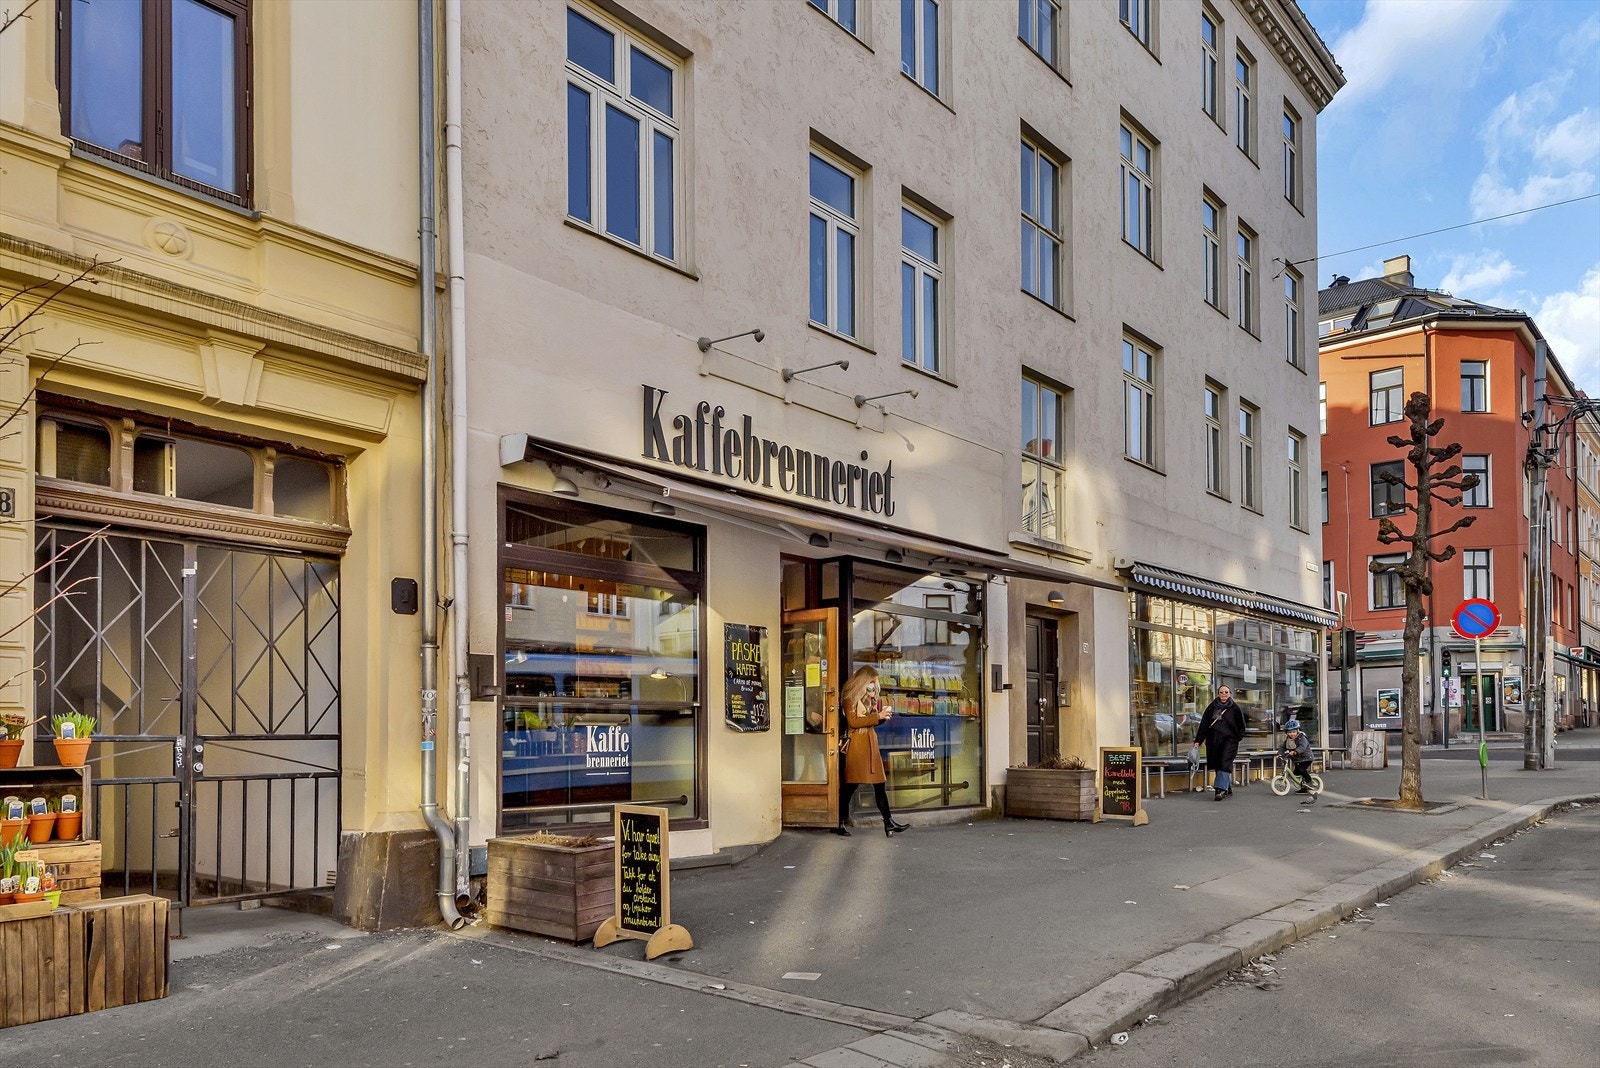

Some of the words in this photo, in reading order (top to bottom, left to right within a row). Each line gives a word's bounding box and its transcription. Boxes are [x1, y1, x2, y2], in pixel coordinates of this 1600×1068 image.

[641, 384, 895, 517] Kaffebrenneriet
[731, 639, 761, 664] PÅSKE
[736, 663, 758, 677] KAFFE
[586, 725, 630, 753] Kaffe
[911, 728, 935, 749] Kaffe
[586, 753, 629, 768] brenneriet
[1108, 754, 1132, 762] BESTE
[620, 819, 631, 841] Vi
[631, 820, 645, 842] har
[621, 845, 632, 864] for
[632, 845, 648, 861] take
[621, 866, 636, 880] Takk
[637, 867, 646, 885] for
[648, 870, 656, 882] at
[622, 882, 632, 893] du
[636, 882, 652, 894] holder
[623, 903, 631, 916] og
